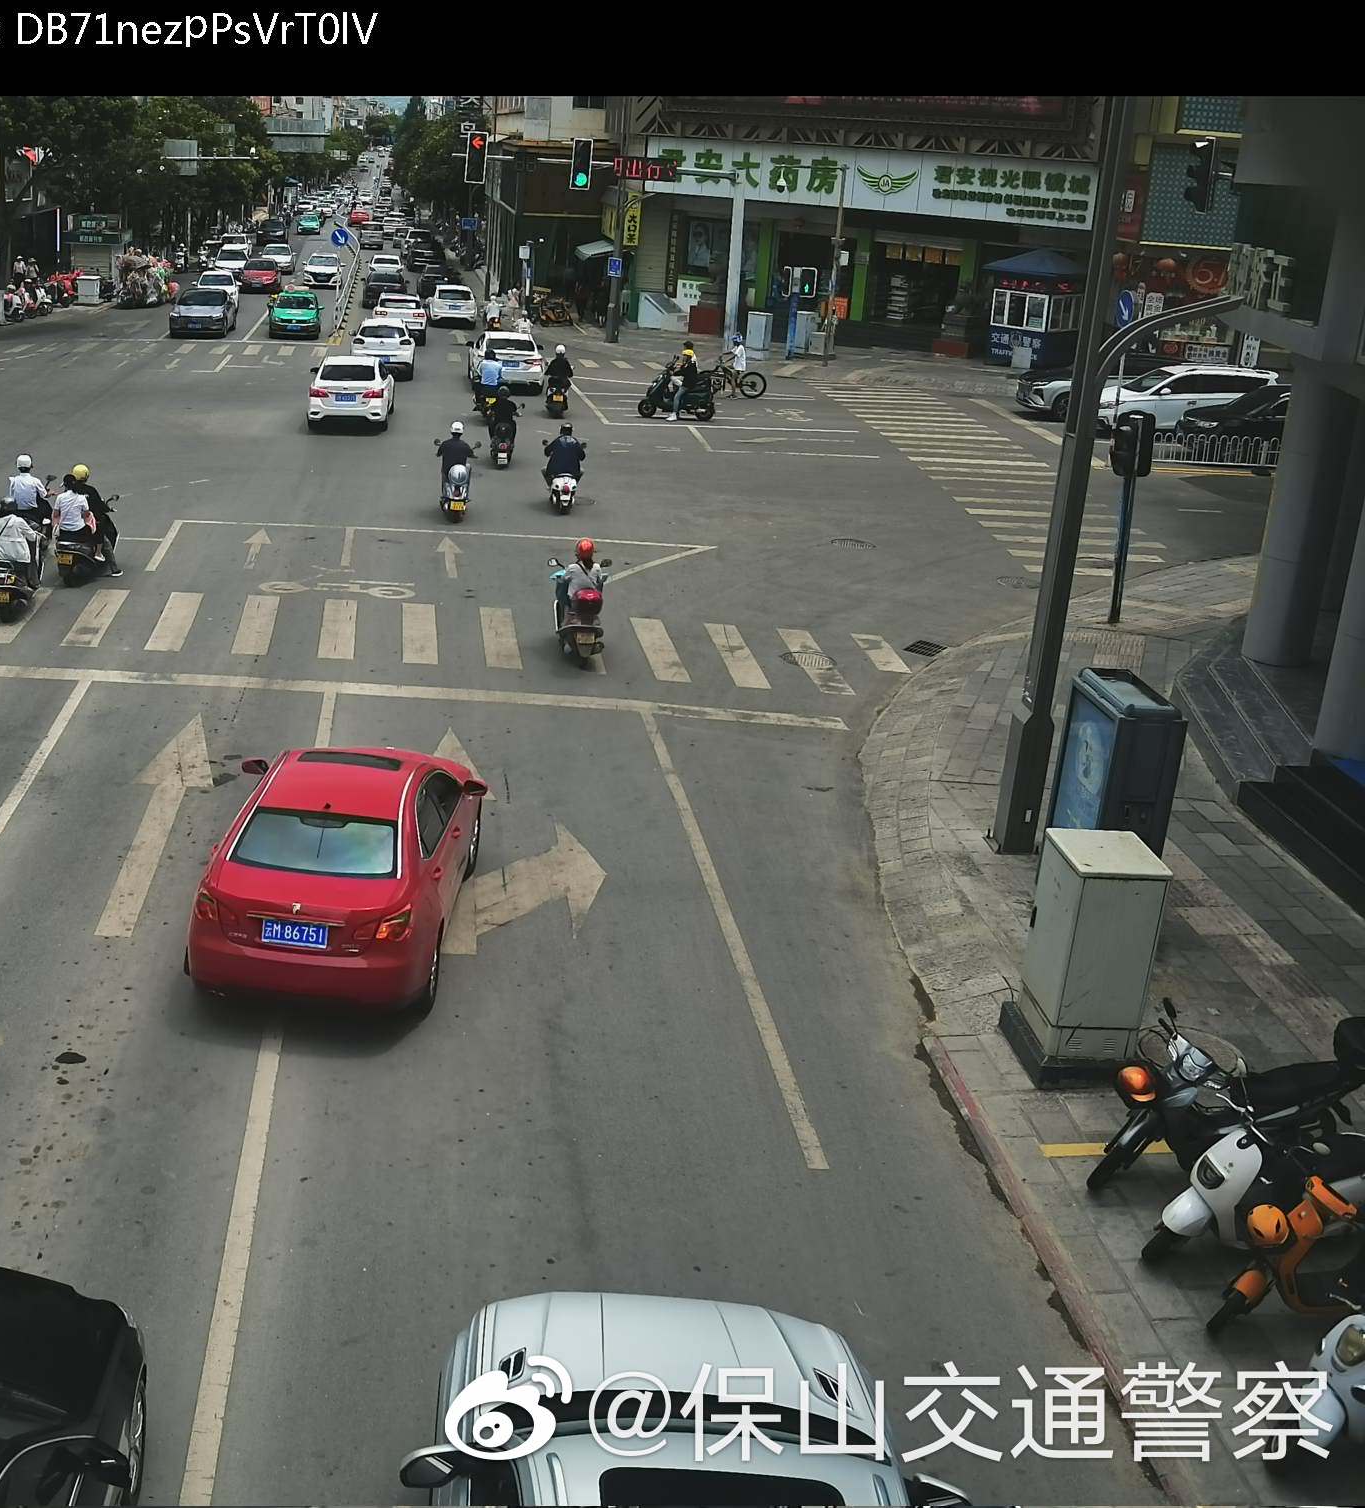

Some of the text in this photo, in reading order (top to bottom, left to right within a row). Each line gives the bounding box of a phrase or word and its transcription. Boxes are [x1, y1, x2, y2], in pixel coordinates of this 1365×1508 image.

[991, 332, 1042, 350] 交通 警察
[265, 922, 324, 944] 云M·86751
